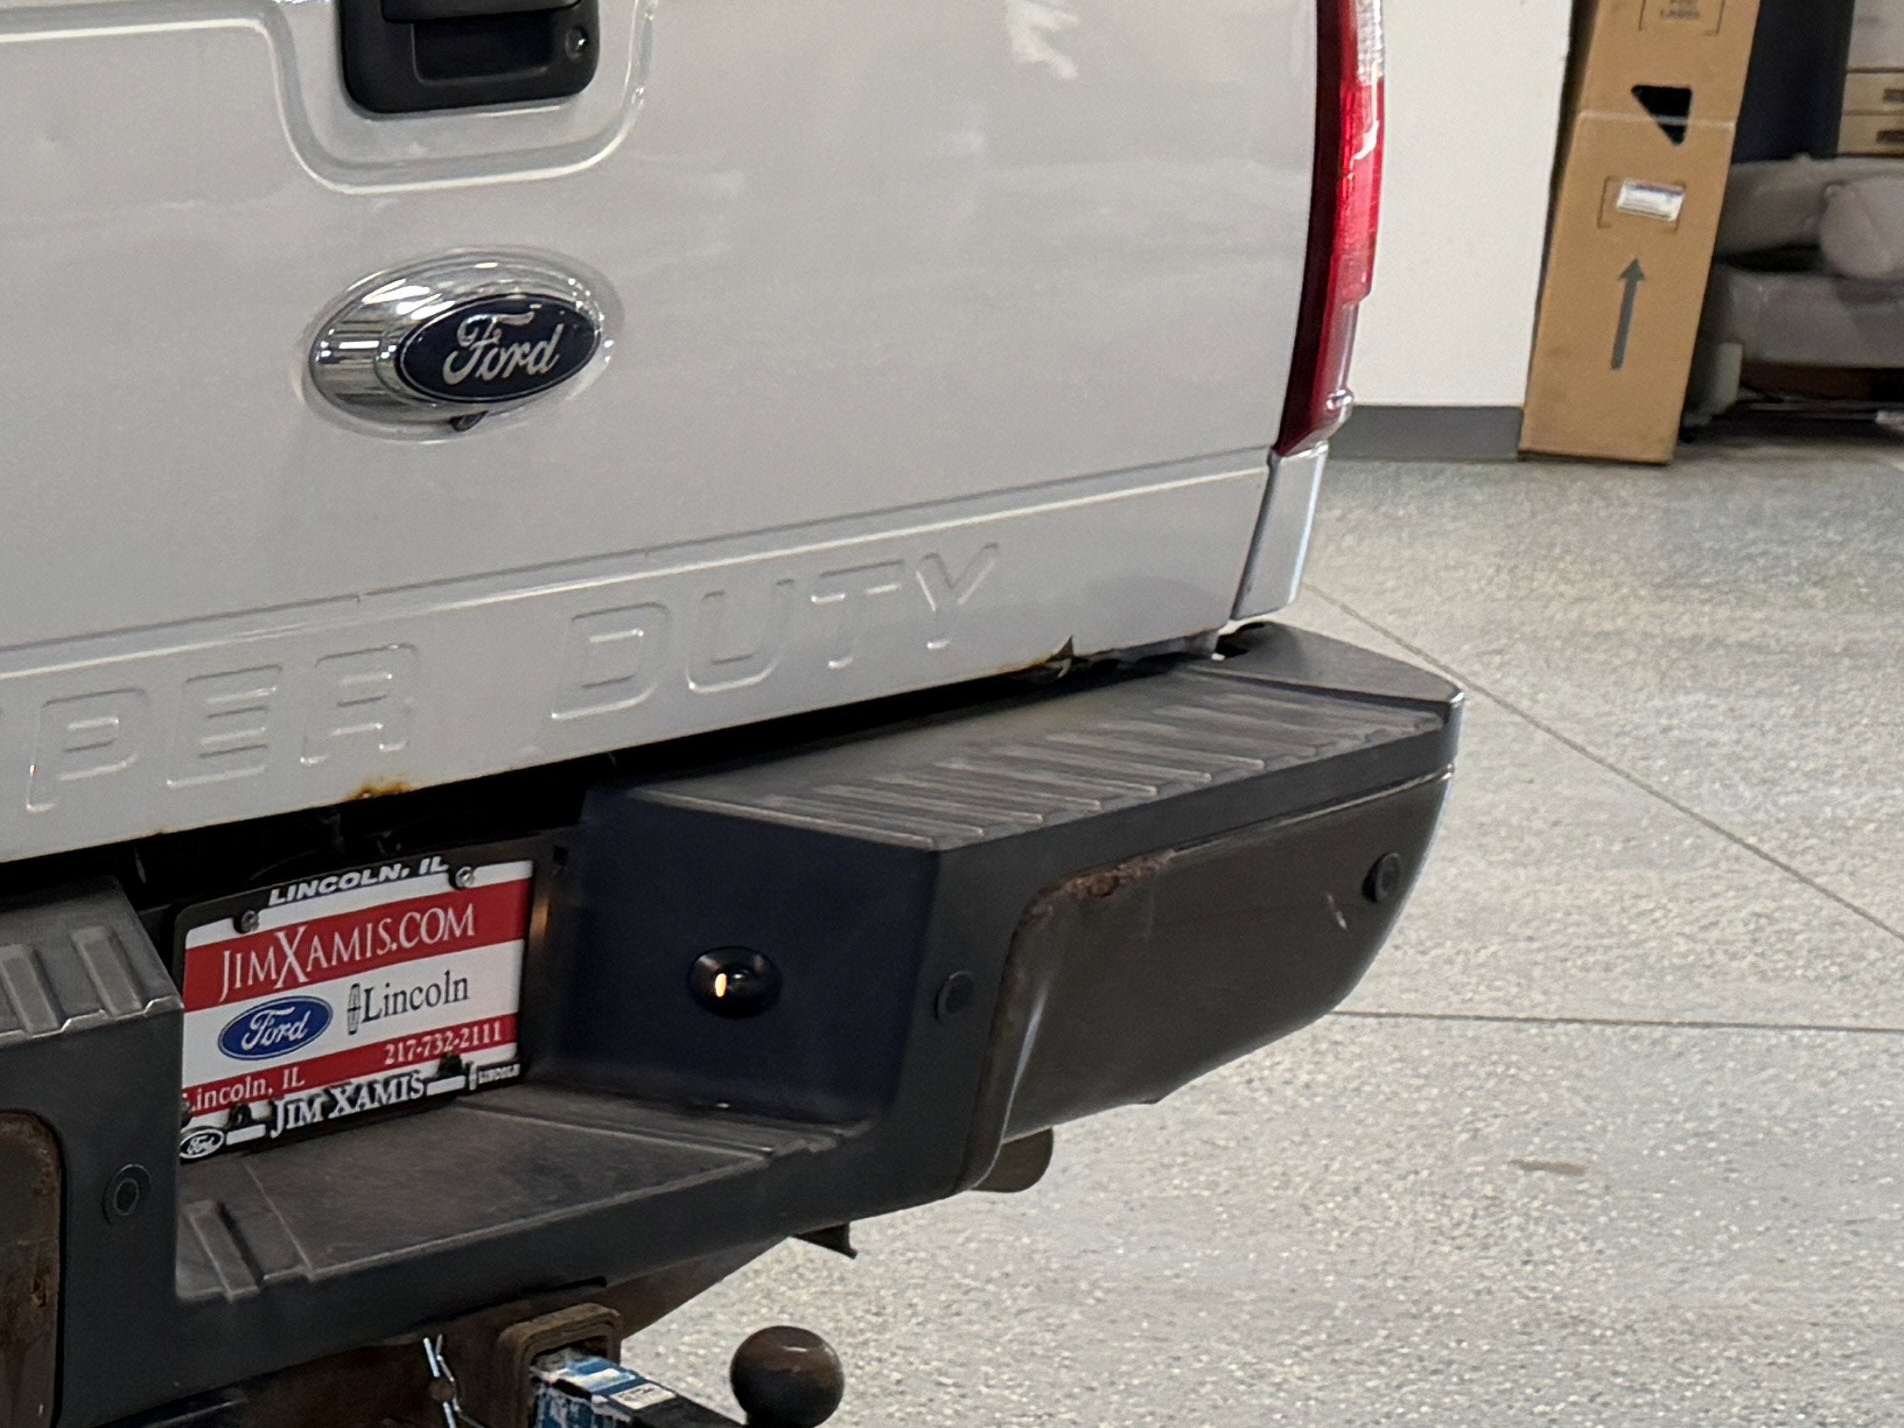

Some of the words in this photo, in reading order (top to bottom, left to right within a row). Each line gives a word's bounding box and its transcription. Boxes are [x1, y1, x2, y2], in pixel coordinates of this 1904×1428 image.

[441, 312, 563, 384] Ford
[553, 542, 999, 722] DUTY
[269, 864, 410, 907] LINCOLN,
[419, 855, 450, 875] IL
[362, 970, 469, 1024] Lincoln
[240, 1006, 309, 1051] Ford
[384, 1025, 502, 1065] 217-732-2111
[282, 1066, 306, 1090] IL
[271, 1093, 324, 1140] JIM
[328, 1072, 426, 1120] XAMIS
